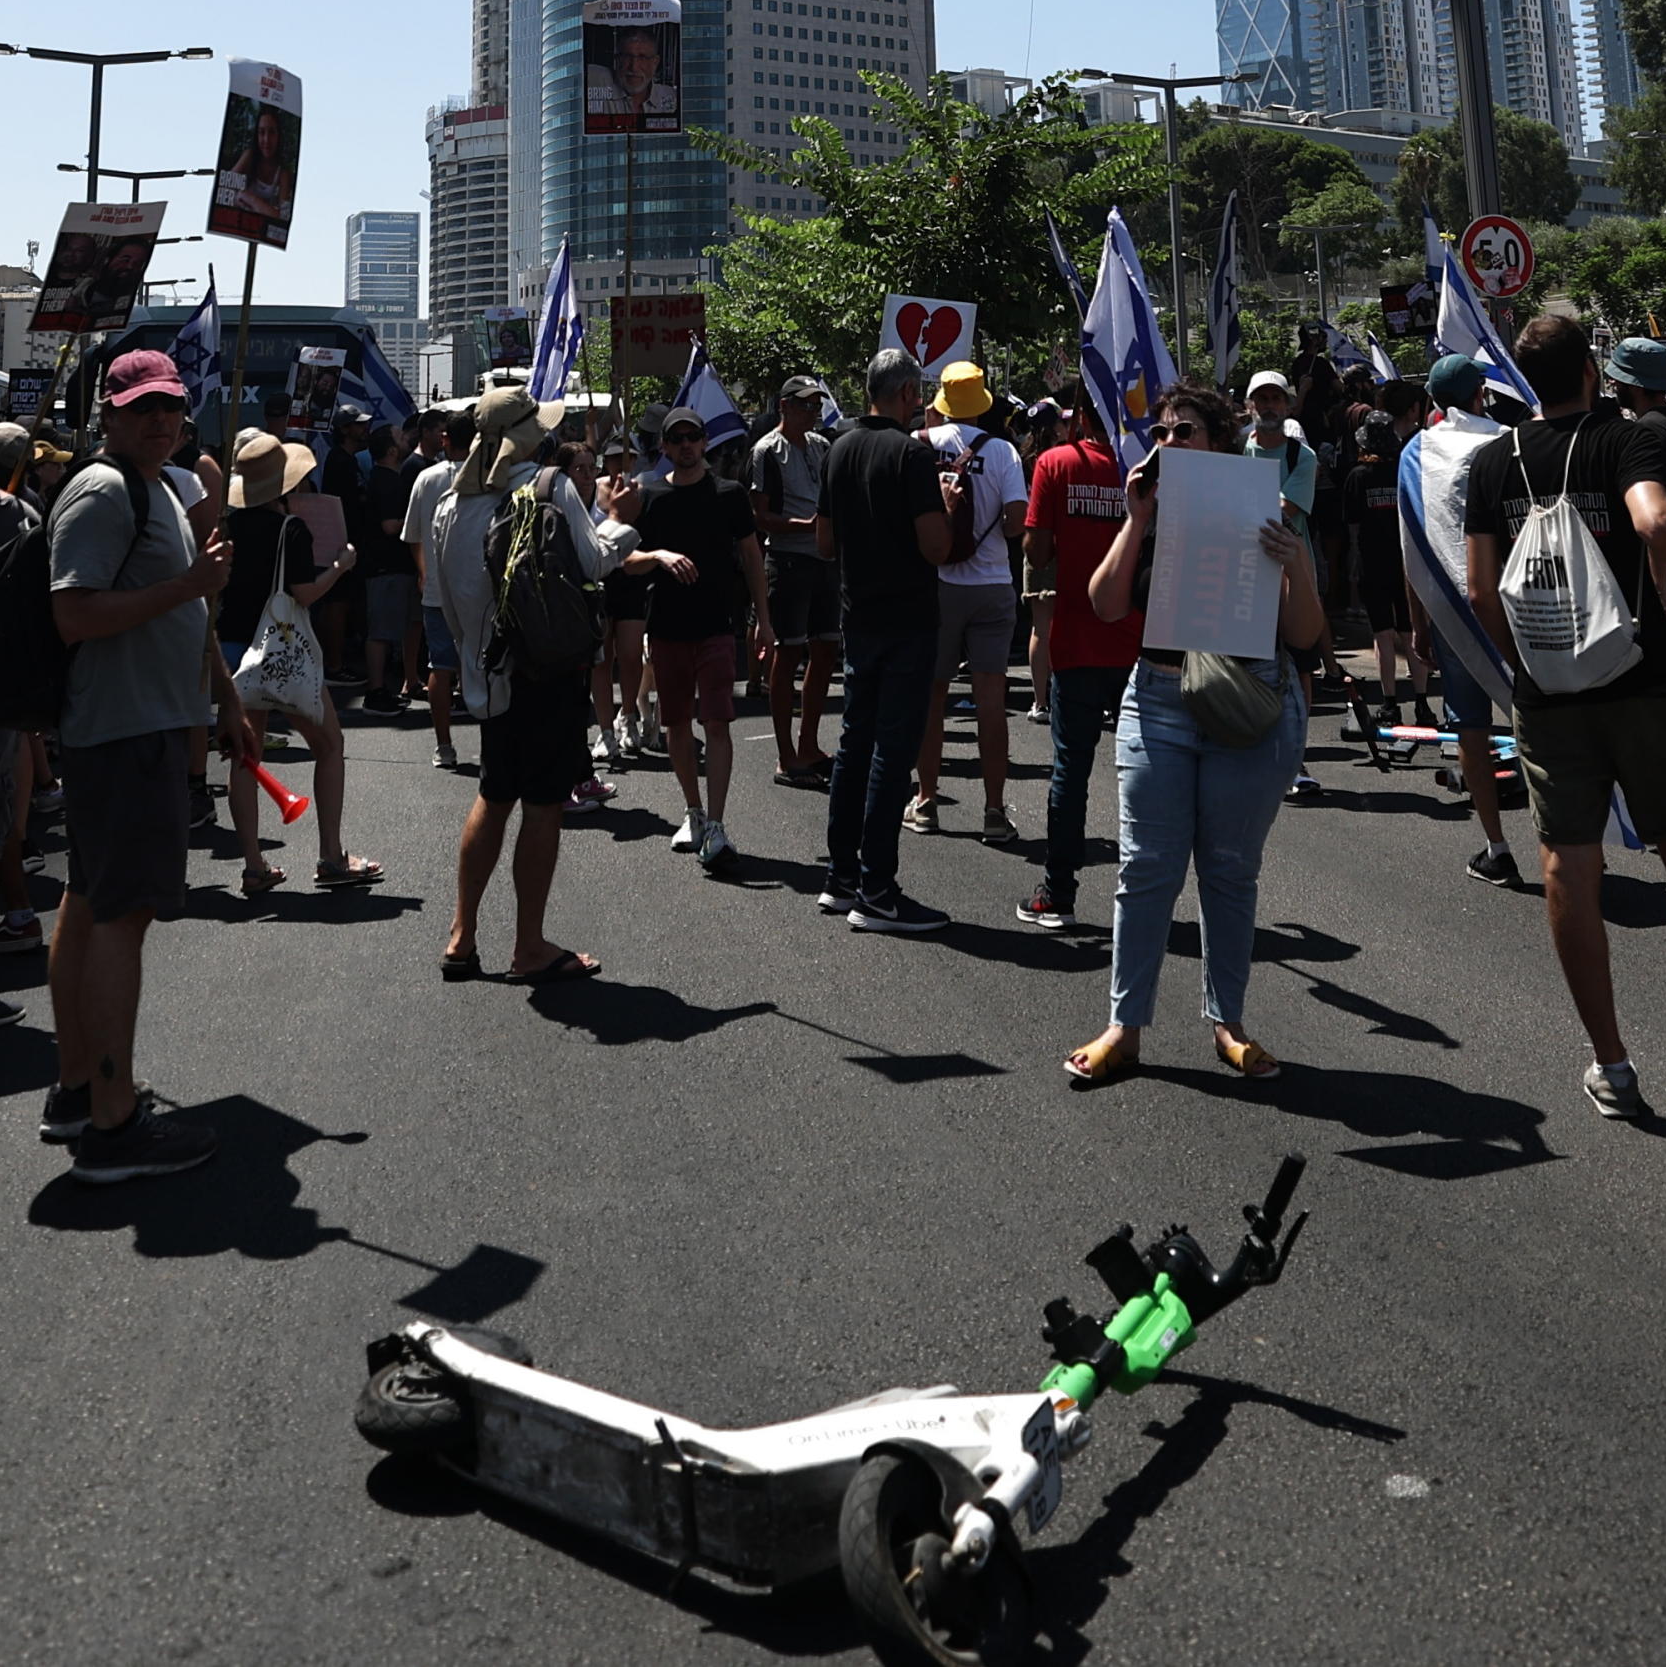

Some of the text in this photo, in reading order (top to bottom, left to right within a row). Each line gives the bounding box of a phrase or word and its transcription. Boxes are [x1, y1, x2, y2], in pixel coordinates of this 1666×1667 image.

[218, 169, 248, 191] BRING
[215, 186, 235, 207] HER
[1099, 485, 1128, 501] שפחות
